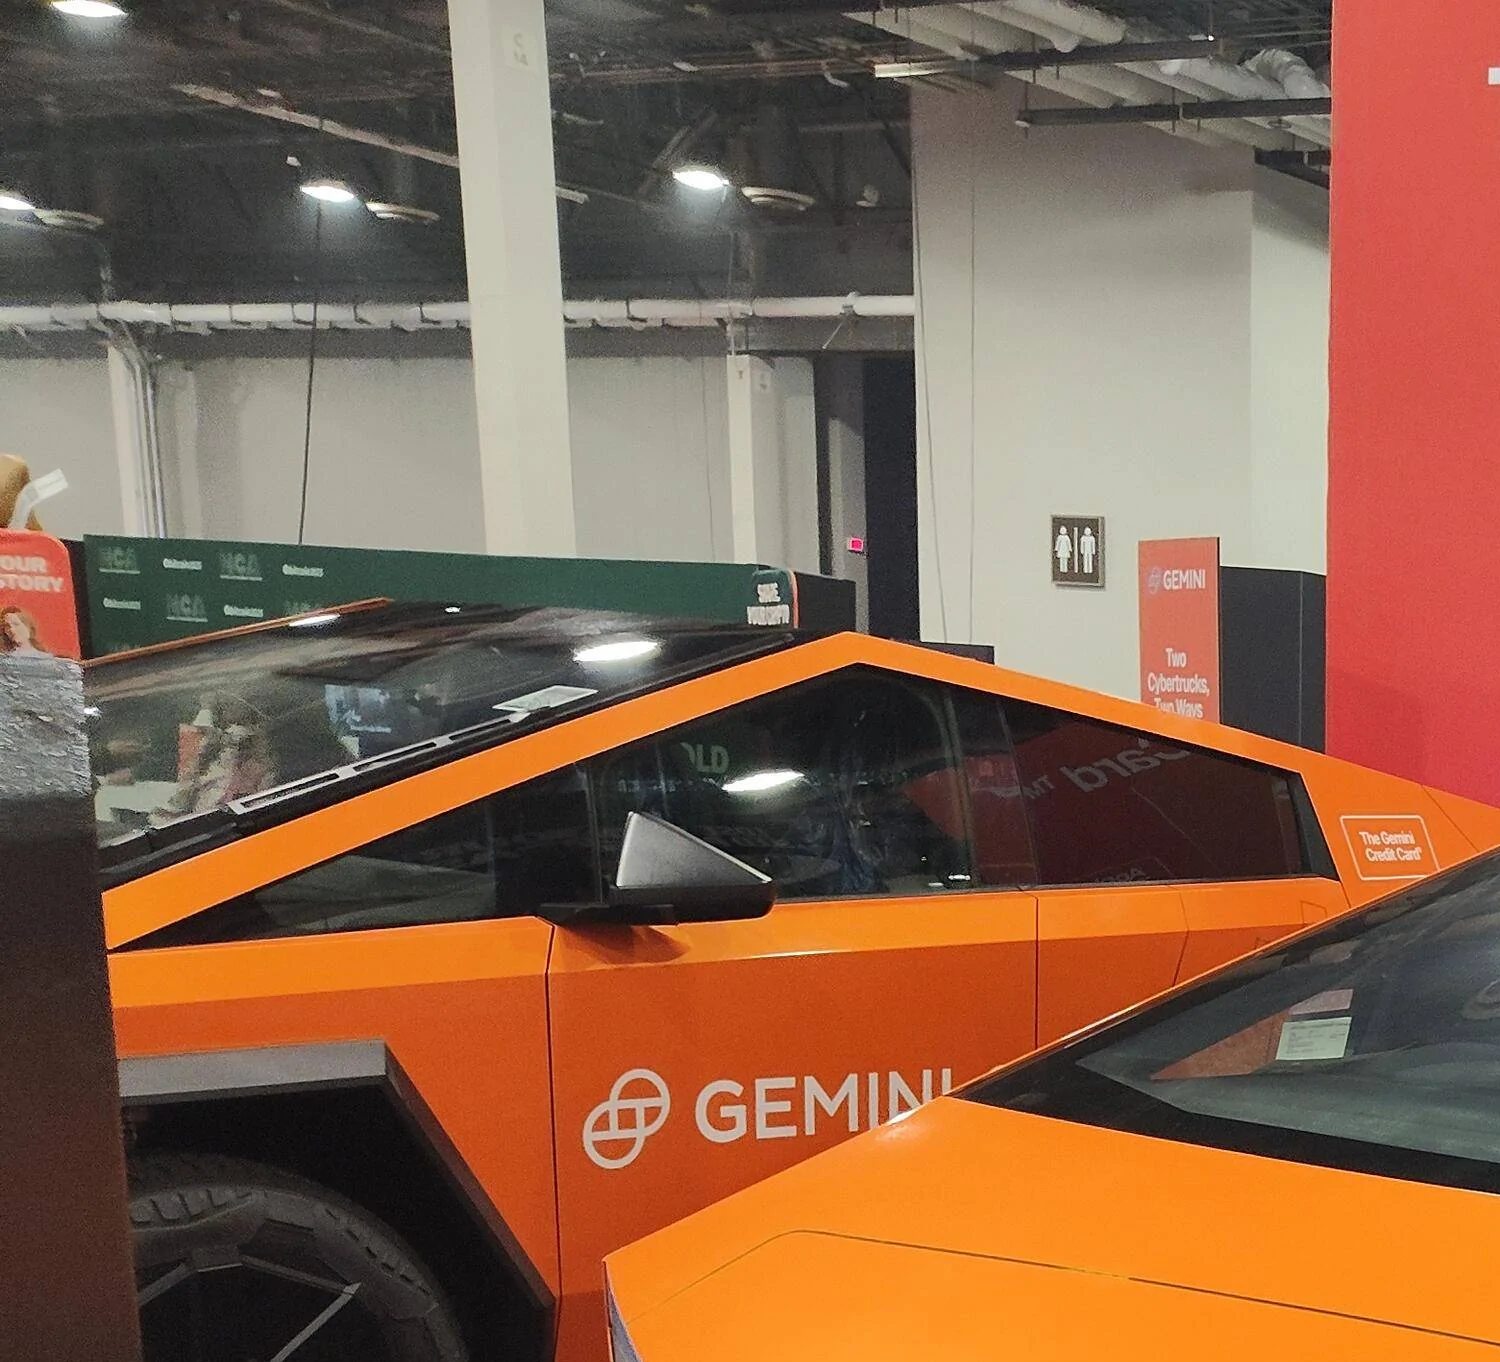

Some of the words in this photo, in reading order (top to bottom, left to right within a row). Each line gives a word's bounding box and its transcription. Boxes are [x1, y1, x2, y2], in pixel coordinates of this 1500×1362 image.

[1163, 569, 1206, 590] GEMINI
[1165, 647, 1187, 668] Two
[1147, 671, 1210, 697] Cybertrucks,
[1175, 698, 1204, 718] Ways
[1358, 831, 1381, 845] The
[1380, 830, 1416, 845] Gemini
[1365, 847, 1398, 861] Credit
